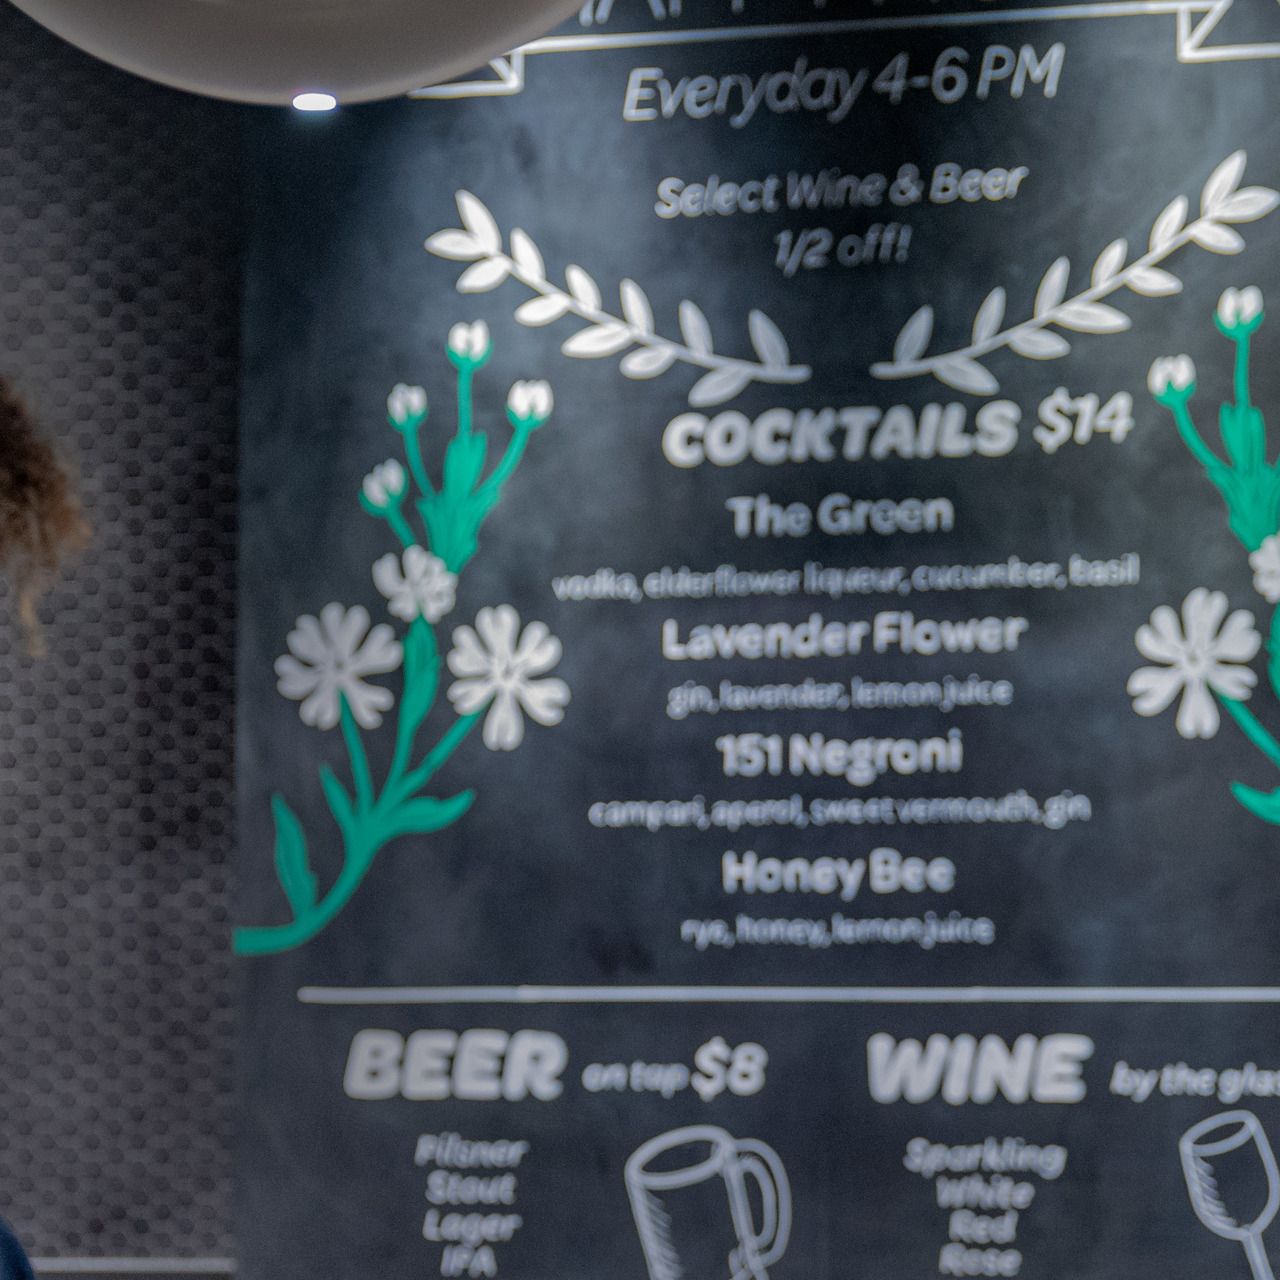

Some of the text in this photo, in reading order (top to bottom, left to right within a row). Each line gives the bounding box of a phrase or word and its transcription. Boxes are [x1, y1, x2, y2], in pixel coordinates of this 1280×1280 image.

[623, 42, 1066, 127] Everyday 4-6 PM
[654, 161, 1030, 219] Select Wine & Beer
[774, 222, 913, 278] 1/2 off!
[662, 386, 1136, 468] COCKTAILS $14
[725, 493, 955, 538] The Green
[552, 567, 643, 603] vodka,
[1068, 552, 1140, 587] basil
[662, 610, 1029, 660] Lavender Flower
[851, 675, 941, 709] lemon
[938, 674, 1014, 713] juice
[716, 727, 963, 787] 151 Negroni
[810, 797, 896, 825] sweet
[1043, 789, 1092, 830] gin
[722, 847, 956, 901] Honey Bee
[832, 912, 923, 946] lemon
[921, 910, 996, 950] juice
[343, 1028, 769, 1103] BEER on tap $8
[866, 1031, 1095, 1106] WINE
[1109, 1061, 1160, 1103] by
[1160, 1062, 1217, 1097] the
[414, 1131, 531, 1169] Pilsner
[902, 1135, 1068, 1180] Sparkling
[425, 1169, 518, 1205] Stout
[935, 1173, 1036, 1210] White
[422, 1208, 523, 1249] Lager
[948, 1208, 1019, 1244] Red
[440, 1243, 498, 1278] IPA
